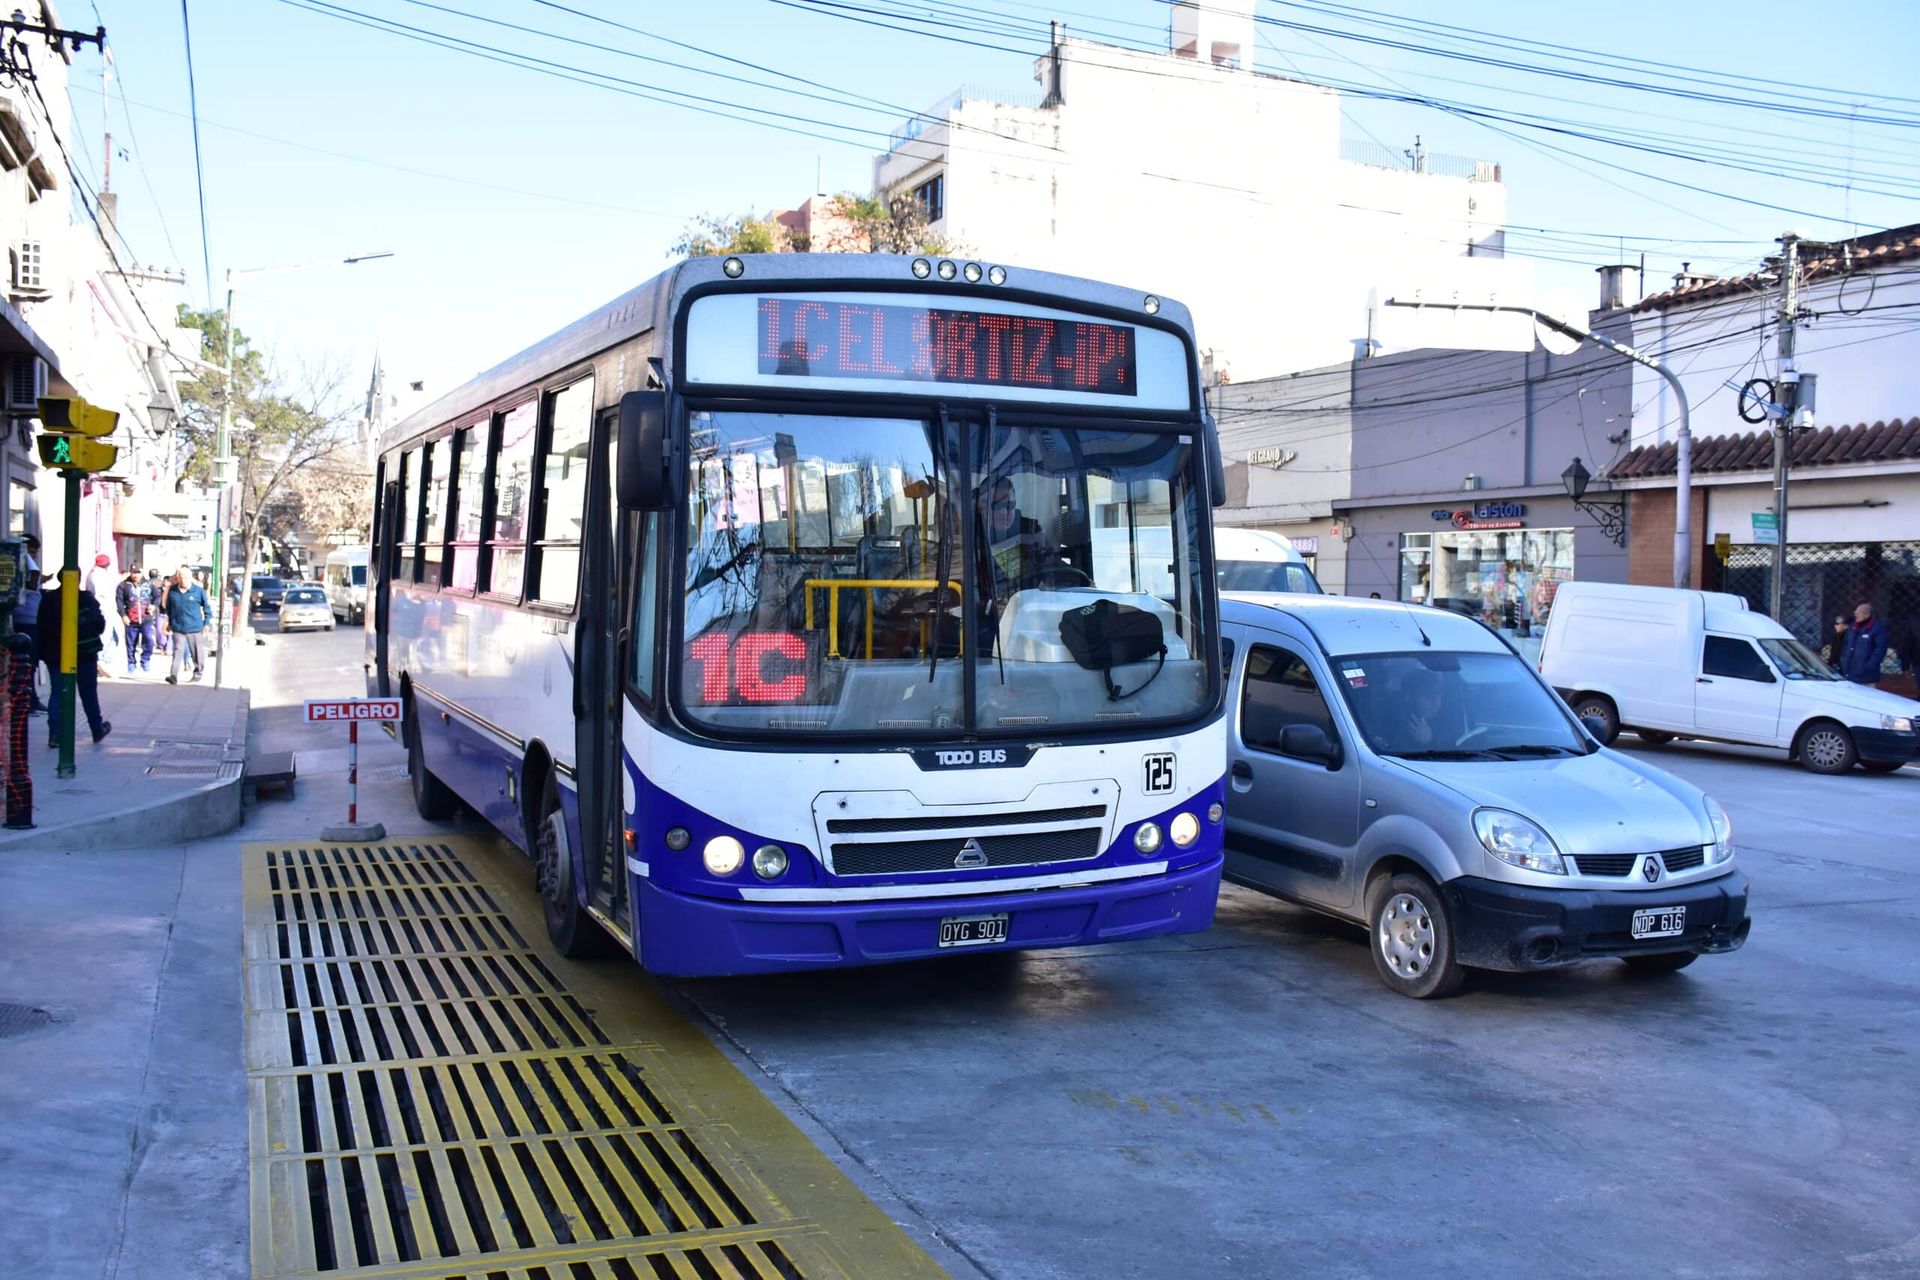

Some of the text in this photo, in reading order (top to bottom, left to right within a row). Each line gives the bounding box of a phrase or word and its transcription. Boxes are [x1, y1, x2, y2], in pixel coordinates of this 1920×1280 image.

[692, 633, 806, 702] 1C
[312, 703, 397, 720] PELIGRO
[935, 749, 1007, 765] TODO BUS
[1145, 756, 1173, 791] 125
[943, 920, 1005, 941] OYG 901
[1634, 913, 1683, 934] NDP 616
